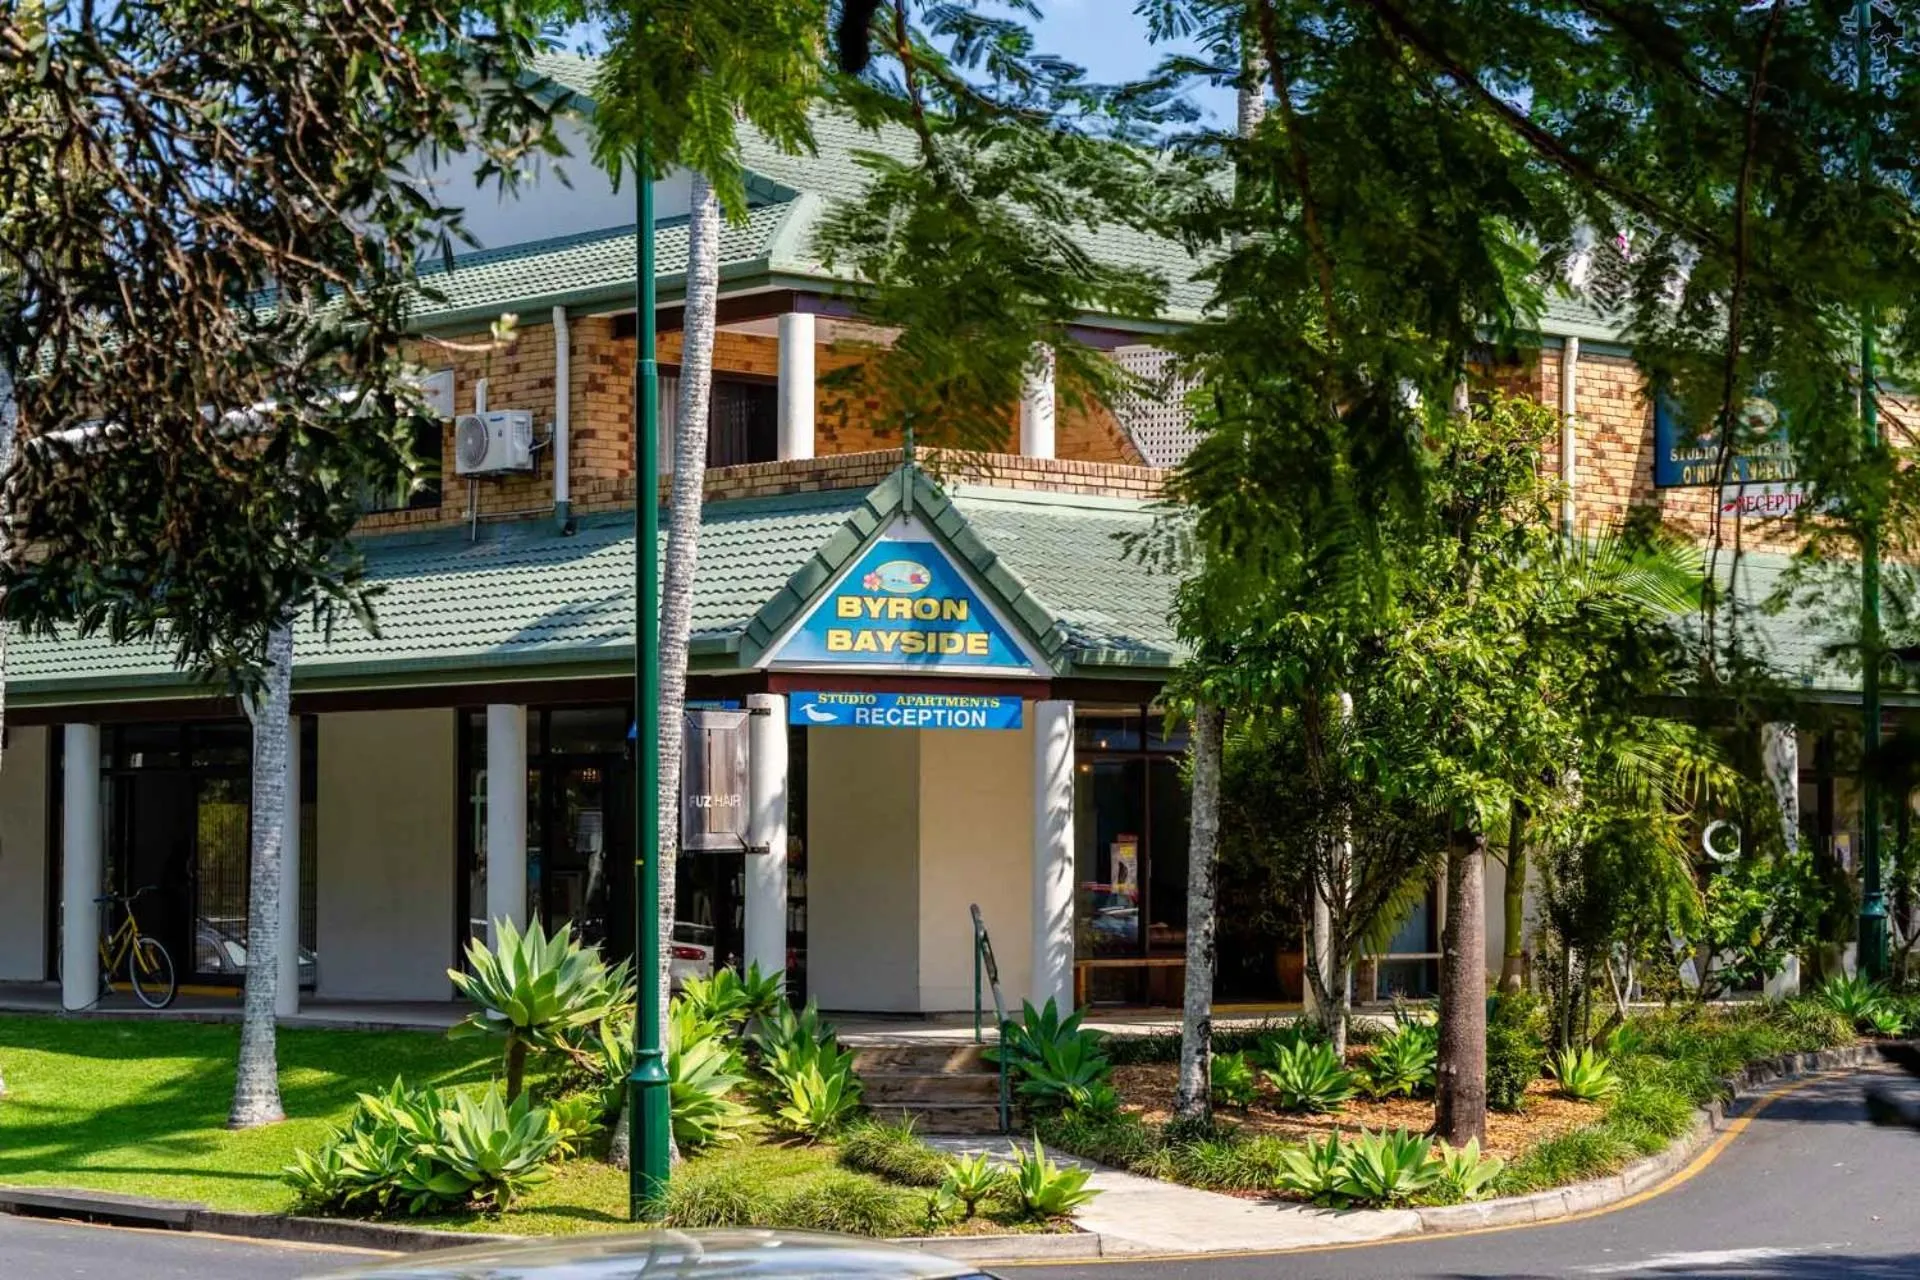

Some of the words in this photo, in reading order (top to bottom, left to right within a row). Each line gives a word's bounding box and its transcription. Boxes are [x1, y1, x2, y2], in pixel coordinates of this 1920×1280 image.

[837, 596, 969, 621] BYRON
[826, 628, 990, 655] BAYSIDE
[818, 693, 877, 705] STUDIO
[896, 695, 1000, 708] APARTMENTS
[855, 707, 987, 728] RECEPTION
[689, 795, 712, 808] FUZ
[715, 794, 741, 808] HAIR
